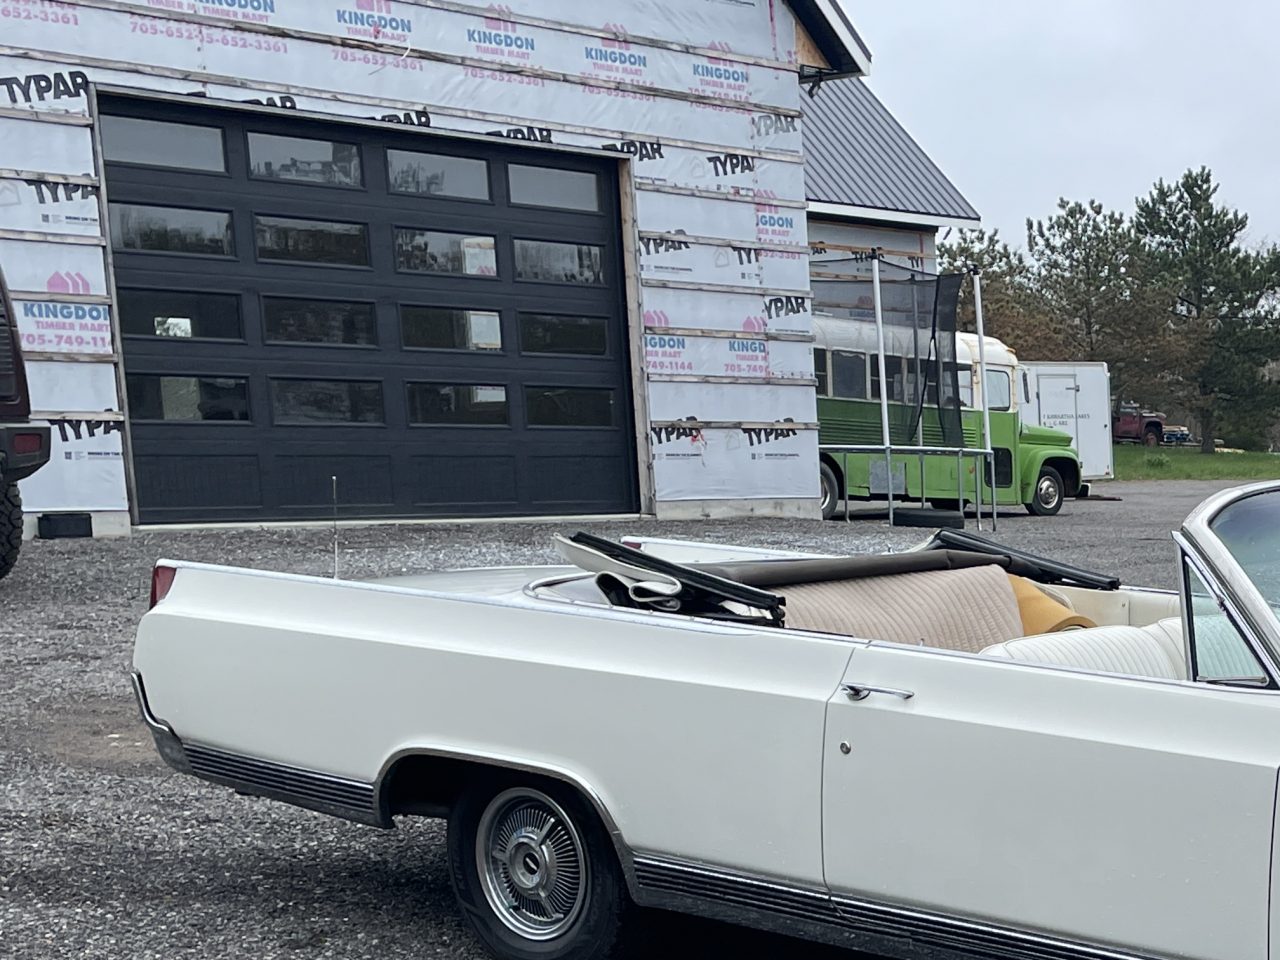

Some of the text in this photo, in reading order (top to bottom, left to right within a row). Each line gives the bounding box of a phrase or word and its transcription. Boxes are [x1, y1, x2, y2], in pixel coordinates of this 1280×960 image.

[337, 9, 412, 33] KINGDON
[467, 29, 535, 51] KINGDON
[585, 46, 647, 68] KINGDON
[693, 63, 749, 83] KINGDON
[0, 71, 88, 103] TYPAR
[35, 320, 109, 333] TIMBER MART
[741, 417, 798, 447] TYPAR
